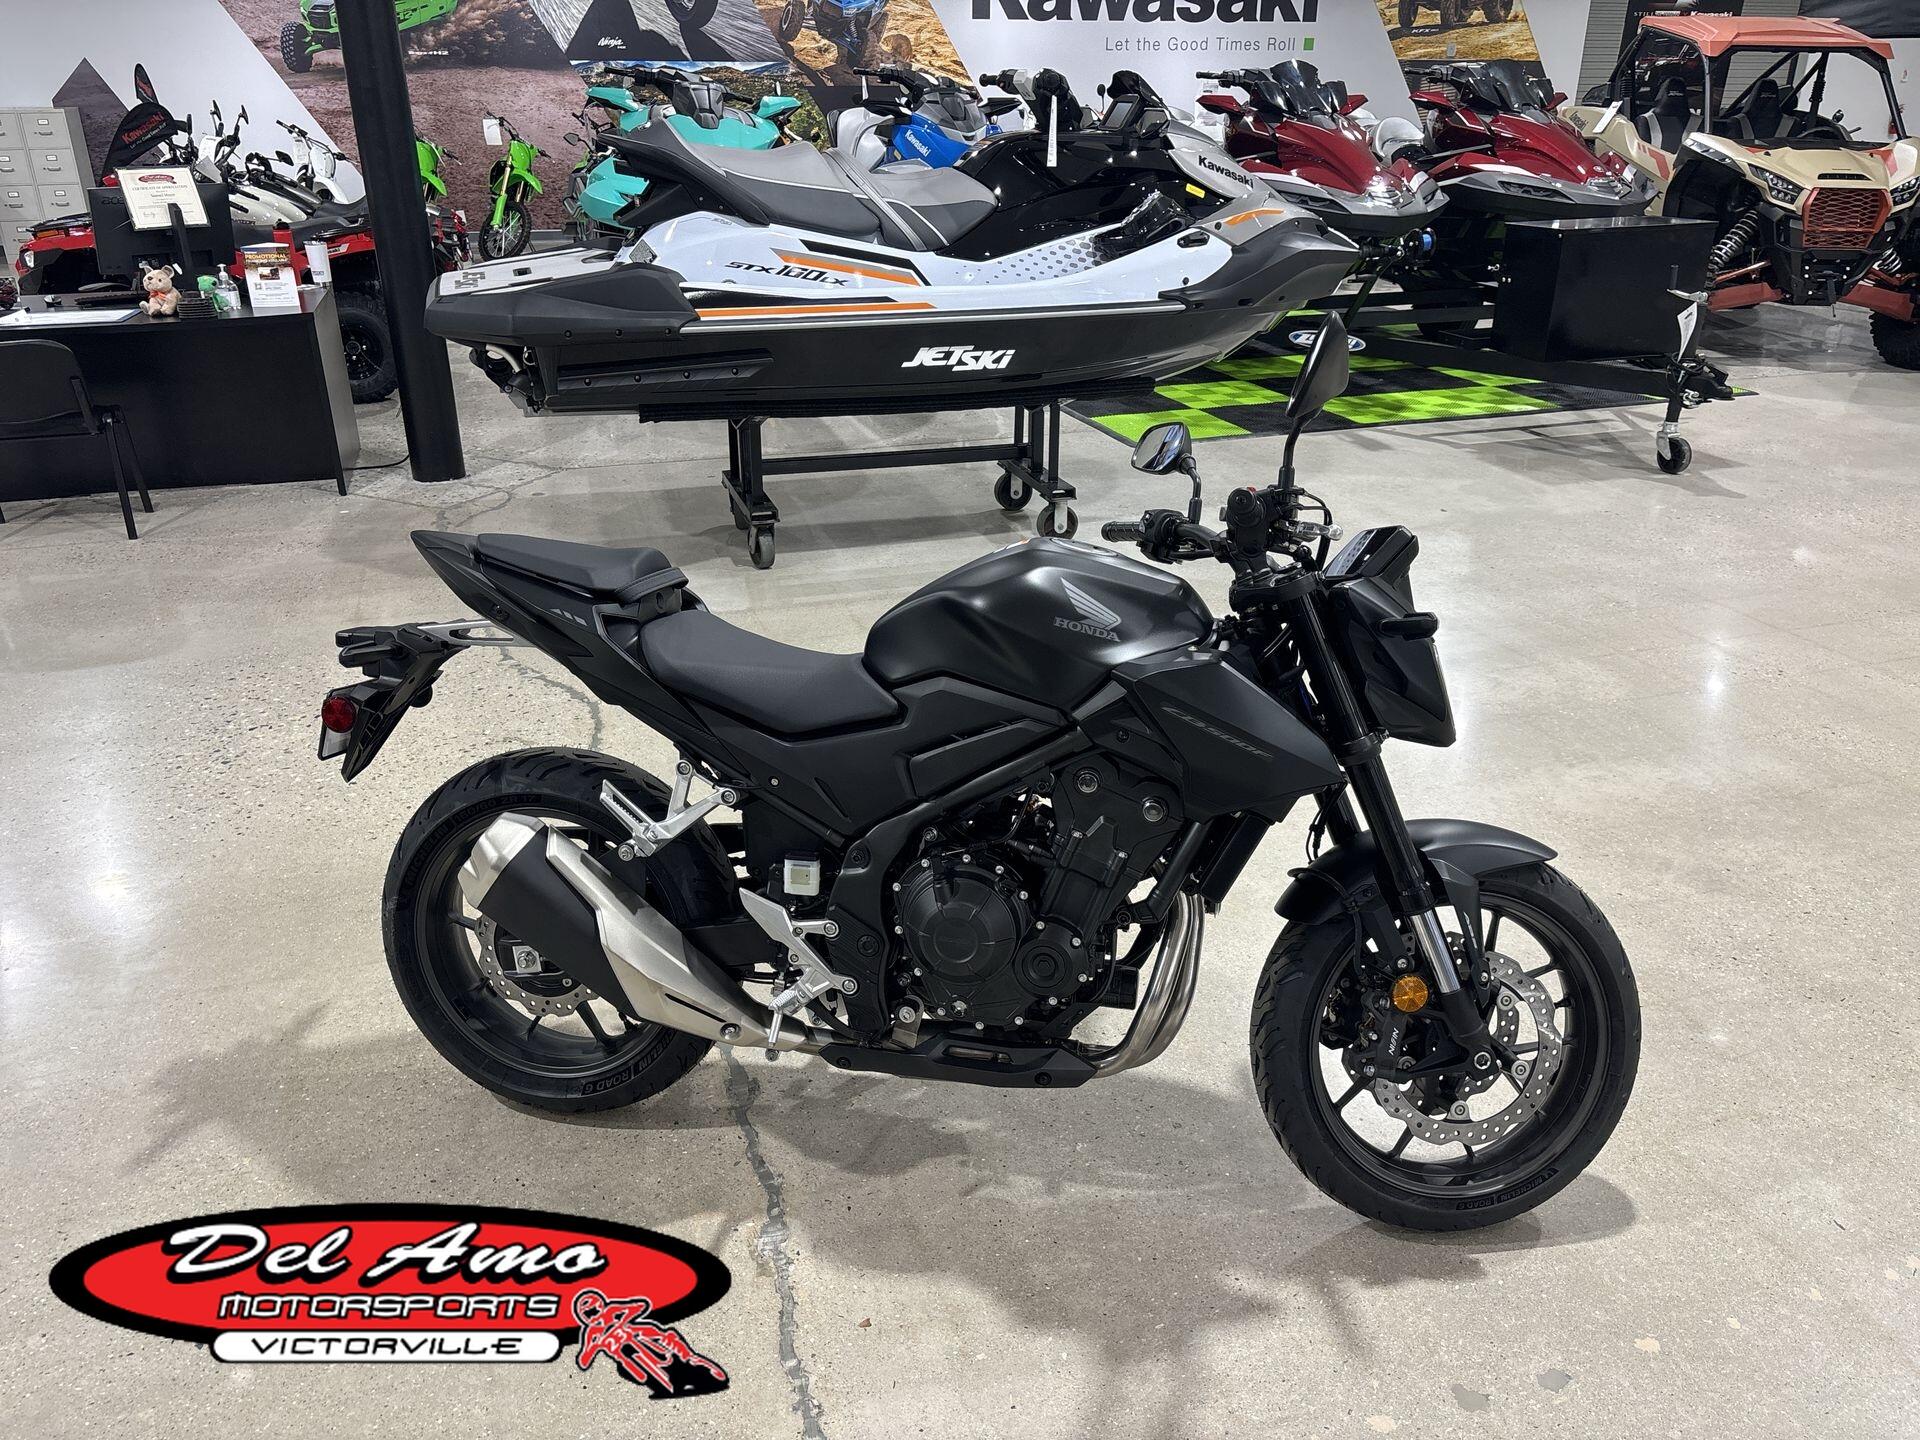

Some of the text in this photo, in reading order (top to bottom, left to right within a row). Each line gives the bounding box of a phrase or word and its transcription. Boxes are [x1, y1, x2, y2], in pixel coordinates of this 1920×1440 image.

[597, 36, 624, 48] Ninja
[1105, 37, 1296, 51] Let the Good Times Roll
[121, 111, 165, 145] Kawasaki
[904, 129, 932, 157] Kawasaki
[1198, 155, 1254, 189] Kawasaki
[102, 196, 124, 205] ace
[1053, 616, 1121, 643] HONDA
[596, 1069, 629, 1091] ROAD
[1500, 1179, 1543, 1202] MICHELIN
[1466, 1199, 1492, 1209] ROAD
